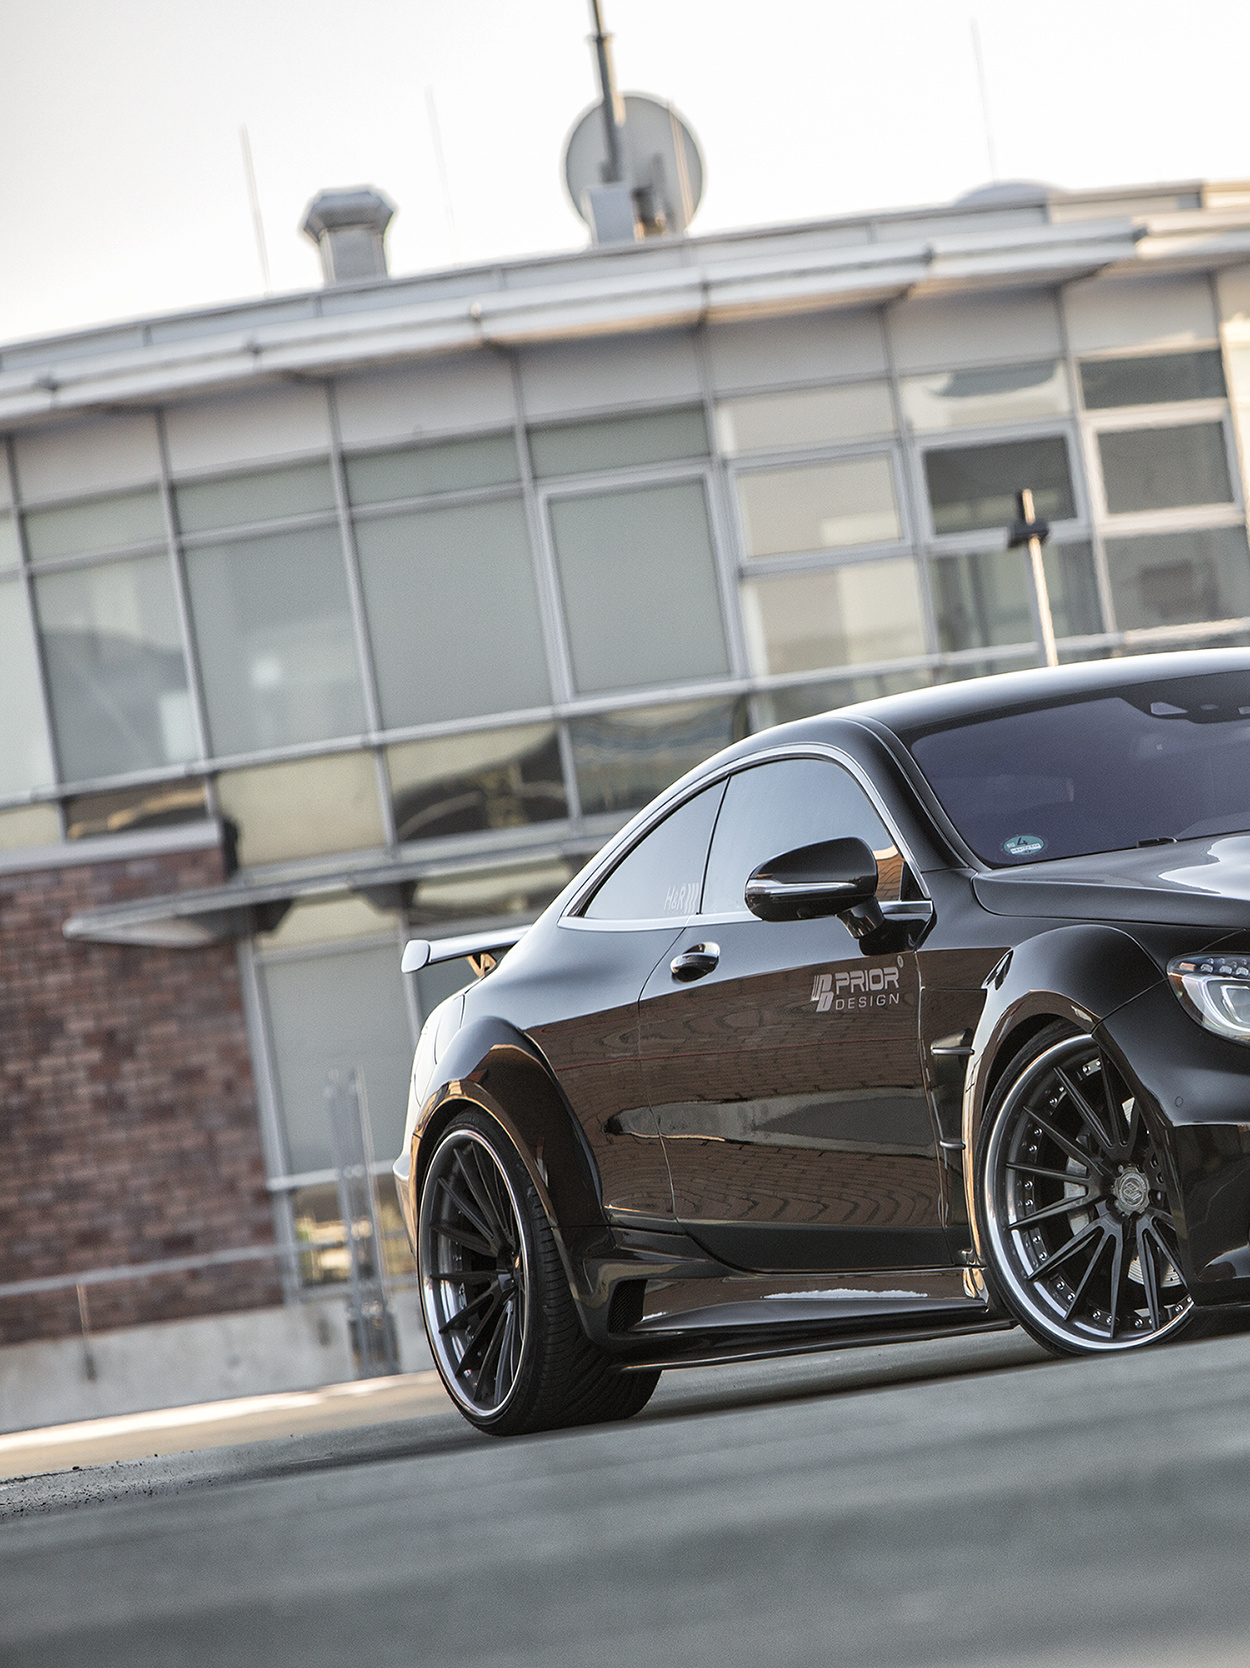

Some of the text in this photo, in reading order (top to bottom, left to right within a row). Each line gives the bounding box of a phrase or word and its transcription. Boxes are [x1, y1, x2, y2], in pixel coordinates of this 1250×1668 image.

[664, 885, 687, 910] H&R
[834, 966, 899, 995] PRIOR
[835, 993, 900, 1011] DESIGN
